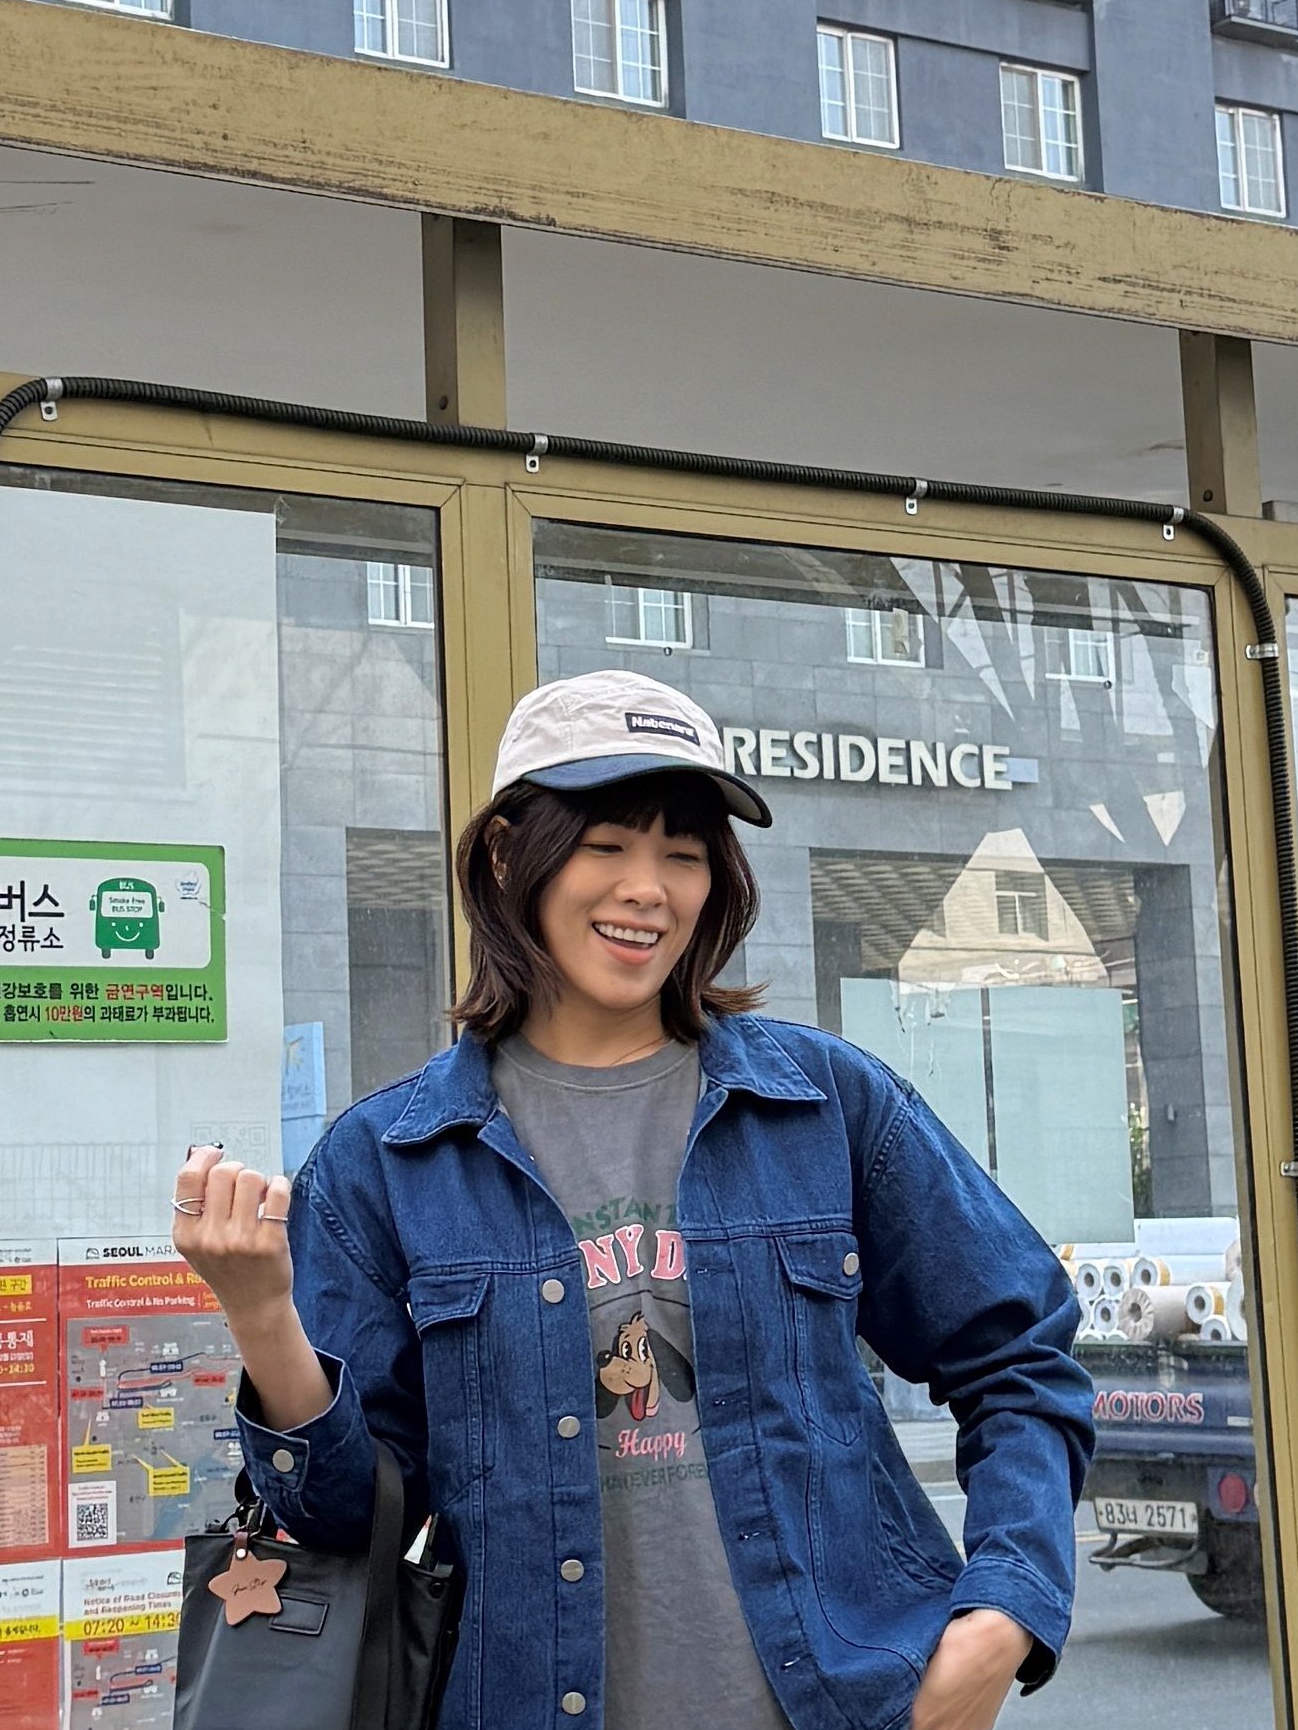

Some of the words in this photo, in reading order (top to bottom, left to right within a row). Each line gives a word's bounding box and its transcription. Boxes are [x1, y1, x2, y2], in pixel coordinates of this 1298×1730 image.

[722, 726, 1012, 790] RESIDENCE
[118, 880, 134, 891] BUS
[69, 982, 100, 1001] 위한
[105, 983, 214, 1002] 금연구역입니다.
[3, 1004, 41, 1022] 흡연시
[45, 1004, 96, 1023] 10만원의
[99, 1005, 148, 1024] 과태료가
[152, 1005, 215, 1024] 부과됩니다.
[102, 1246, 143, 1258] SEOUL
[85, 1275, 127, 1289] Traffic
[128, 1272, 174, 1288] Control
[615, 1428, 687, 1461] Happy
[1144, 1504, 1187, 1529] 2571
[83, 1618, 125, 1637] 07:20
